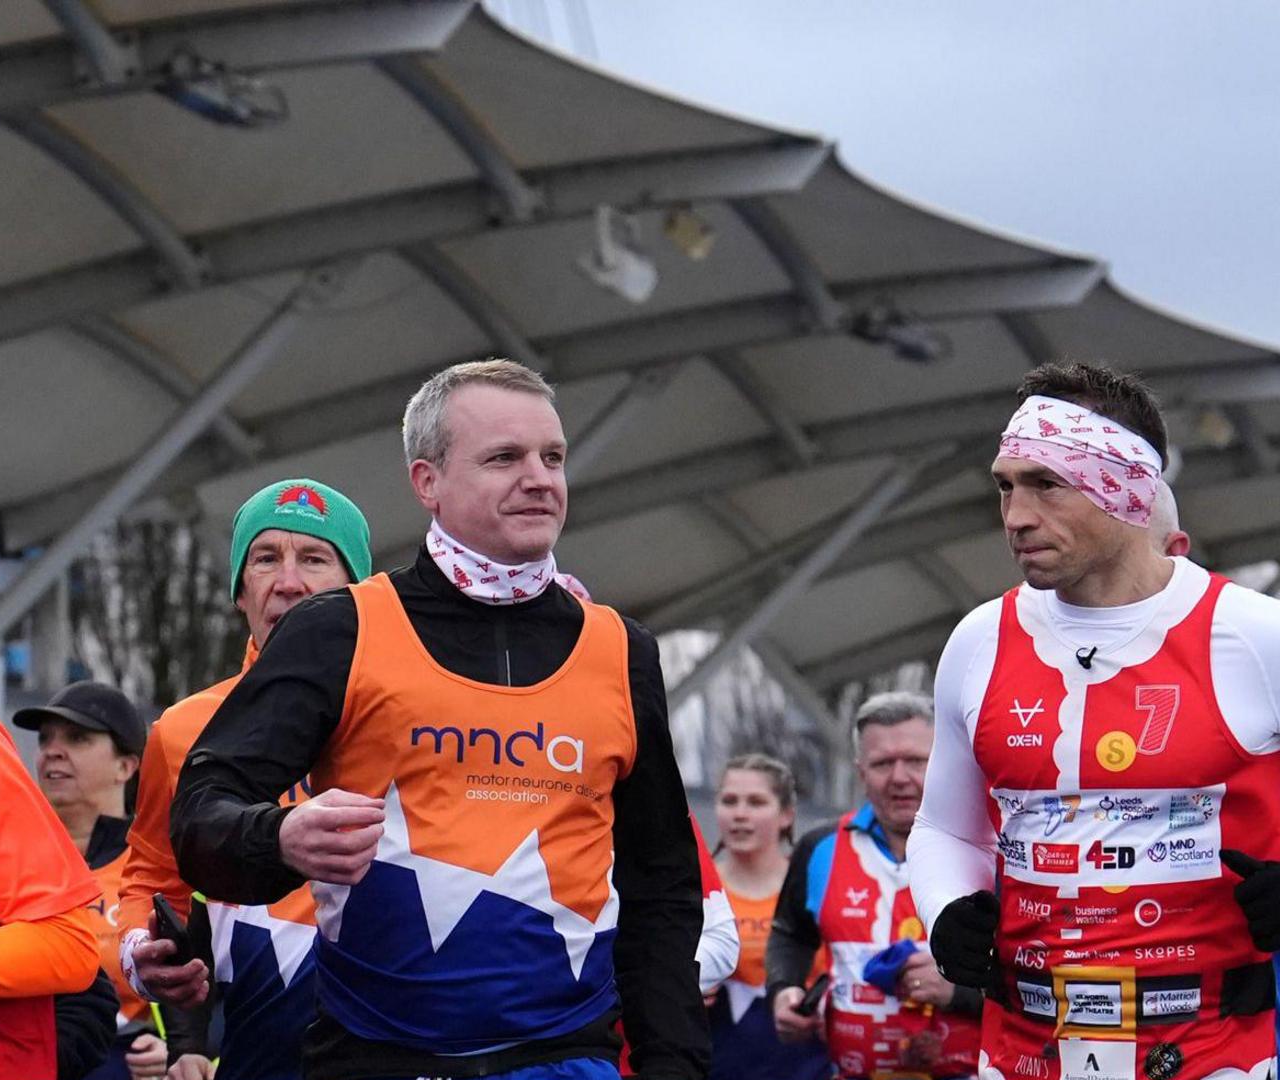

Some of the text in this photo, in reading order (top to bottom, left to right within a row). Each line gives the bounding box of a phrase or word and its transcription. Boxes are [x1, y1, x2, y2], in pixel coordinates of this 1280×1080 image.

[1135, 684, 1180, 756] 7
[411, 721, 584, 774] mnda
[1007, 735, 1042, 747] OXEN
[466, 774, 509, 786] motor
[512, 778, 572, 792] neurone
[465, 789, 549, 804] association
[1169, 838, 1196, 850] MND
[1169, 848, 1214, 862] Scotland
[1075, 905, 1118, 915] business
[1135, 944, 1196, 960] SKOPES
[1160, 991, 1197, 1001] Mattioli
[1160, 1001, 1192, 1012] Woods
